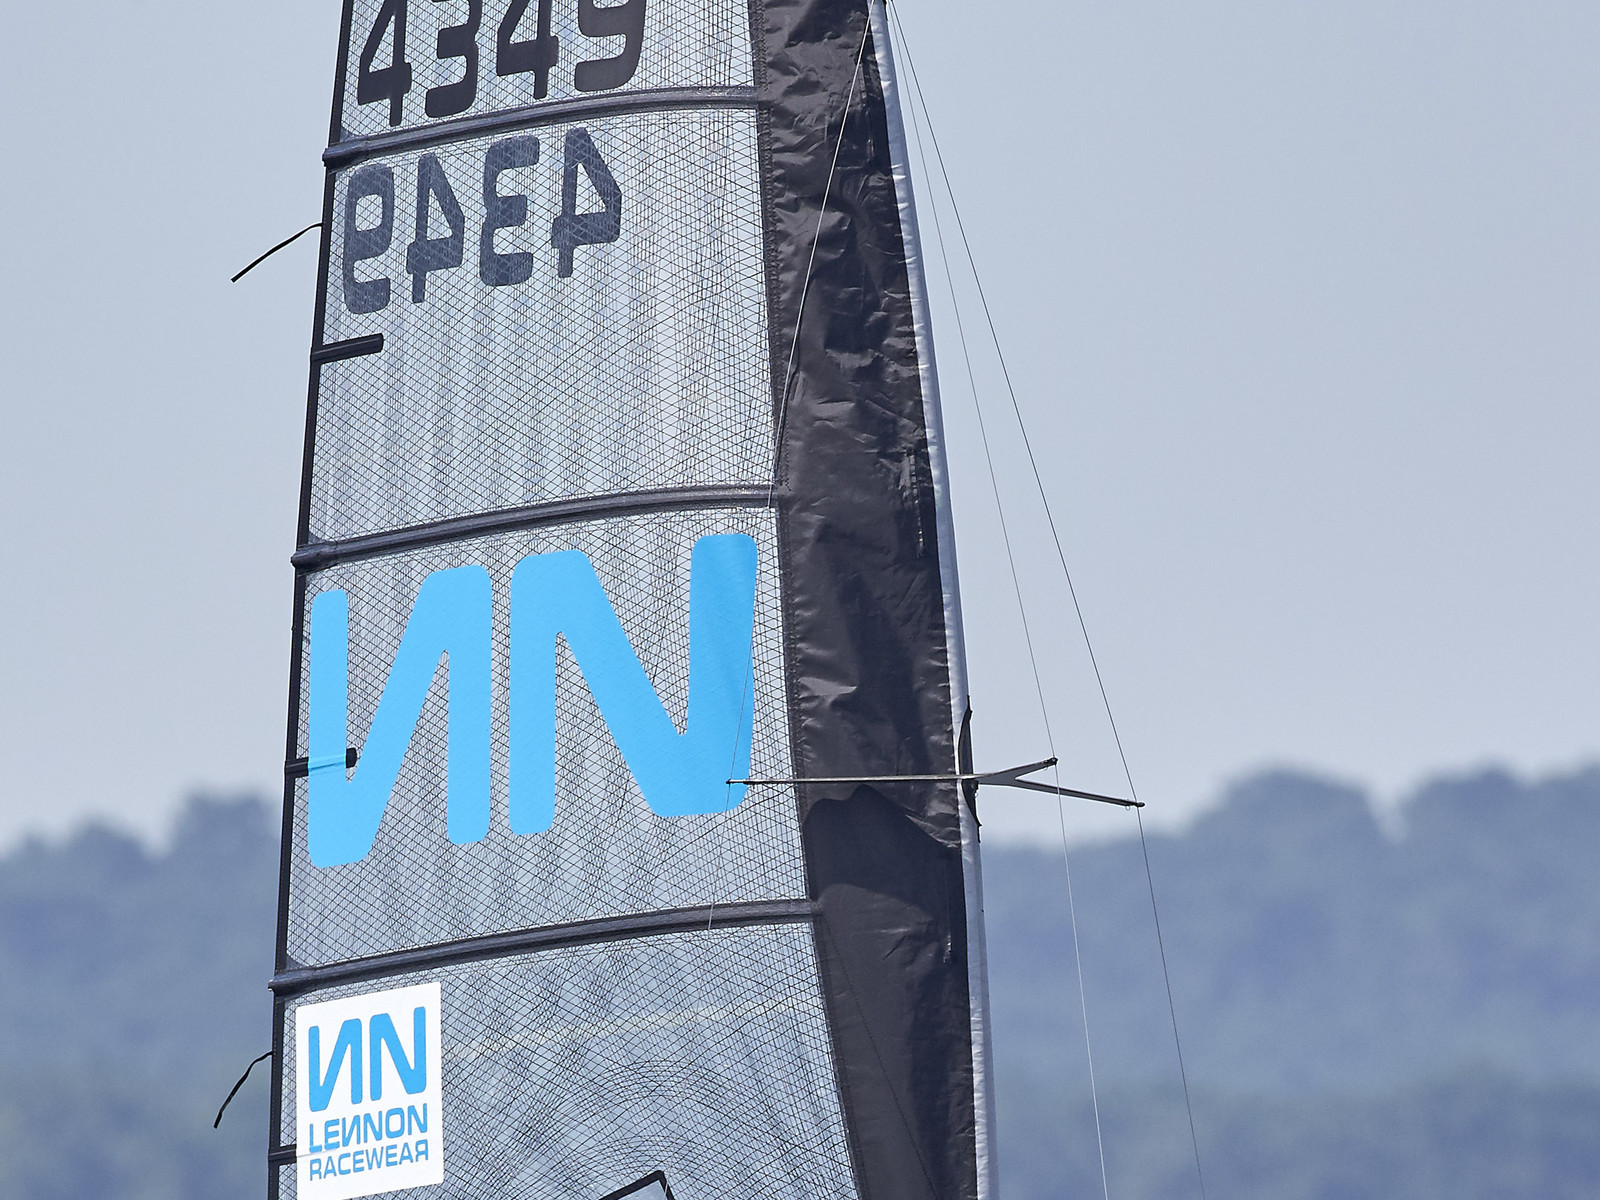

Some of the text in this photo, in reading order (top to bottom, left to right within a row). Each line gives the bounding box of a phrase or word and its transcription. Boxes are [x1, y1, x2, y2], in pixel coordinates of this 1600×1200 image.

[357, 0, 647, 127] 4349
[309, 1103, 429, 1154] LENNON
[309, 1139, 430, 1182] RACEWEAR
